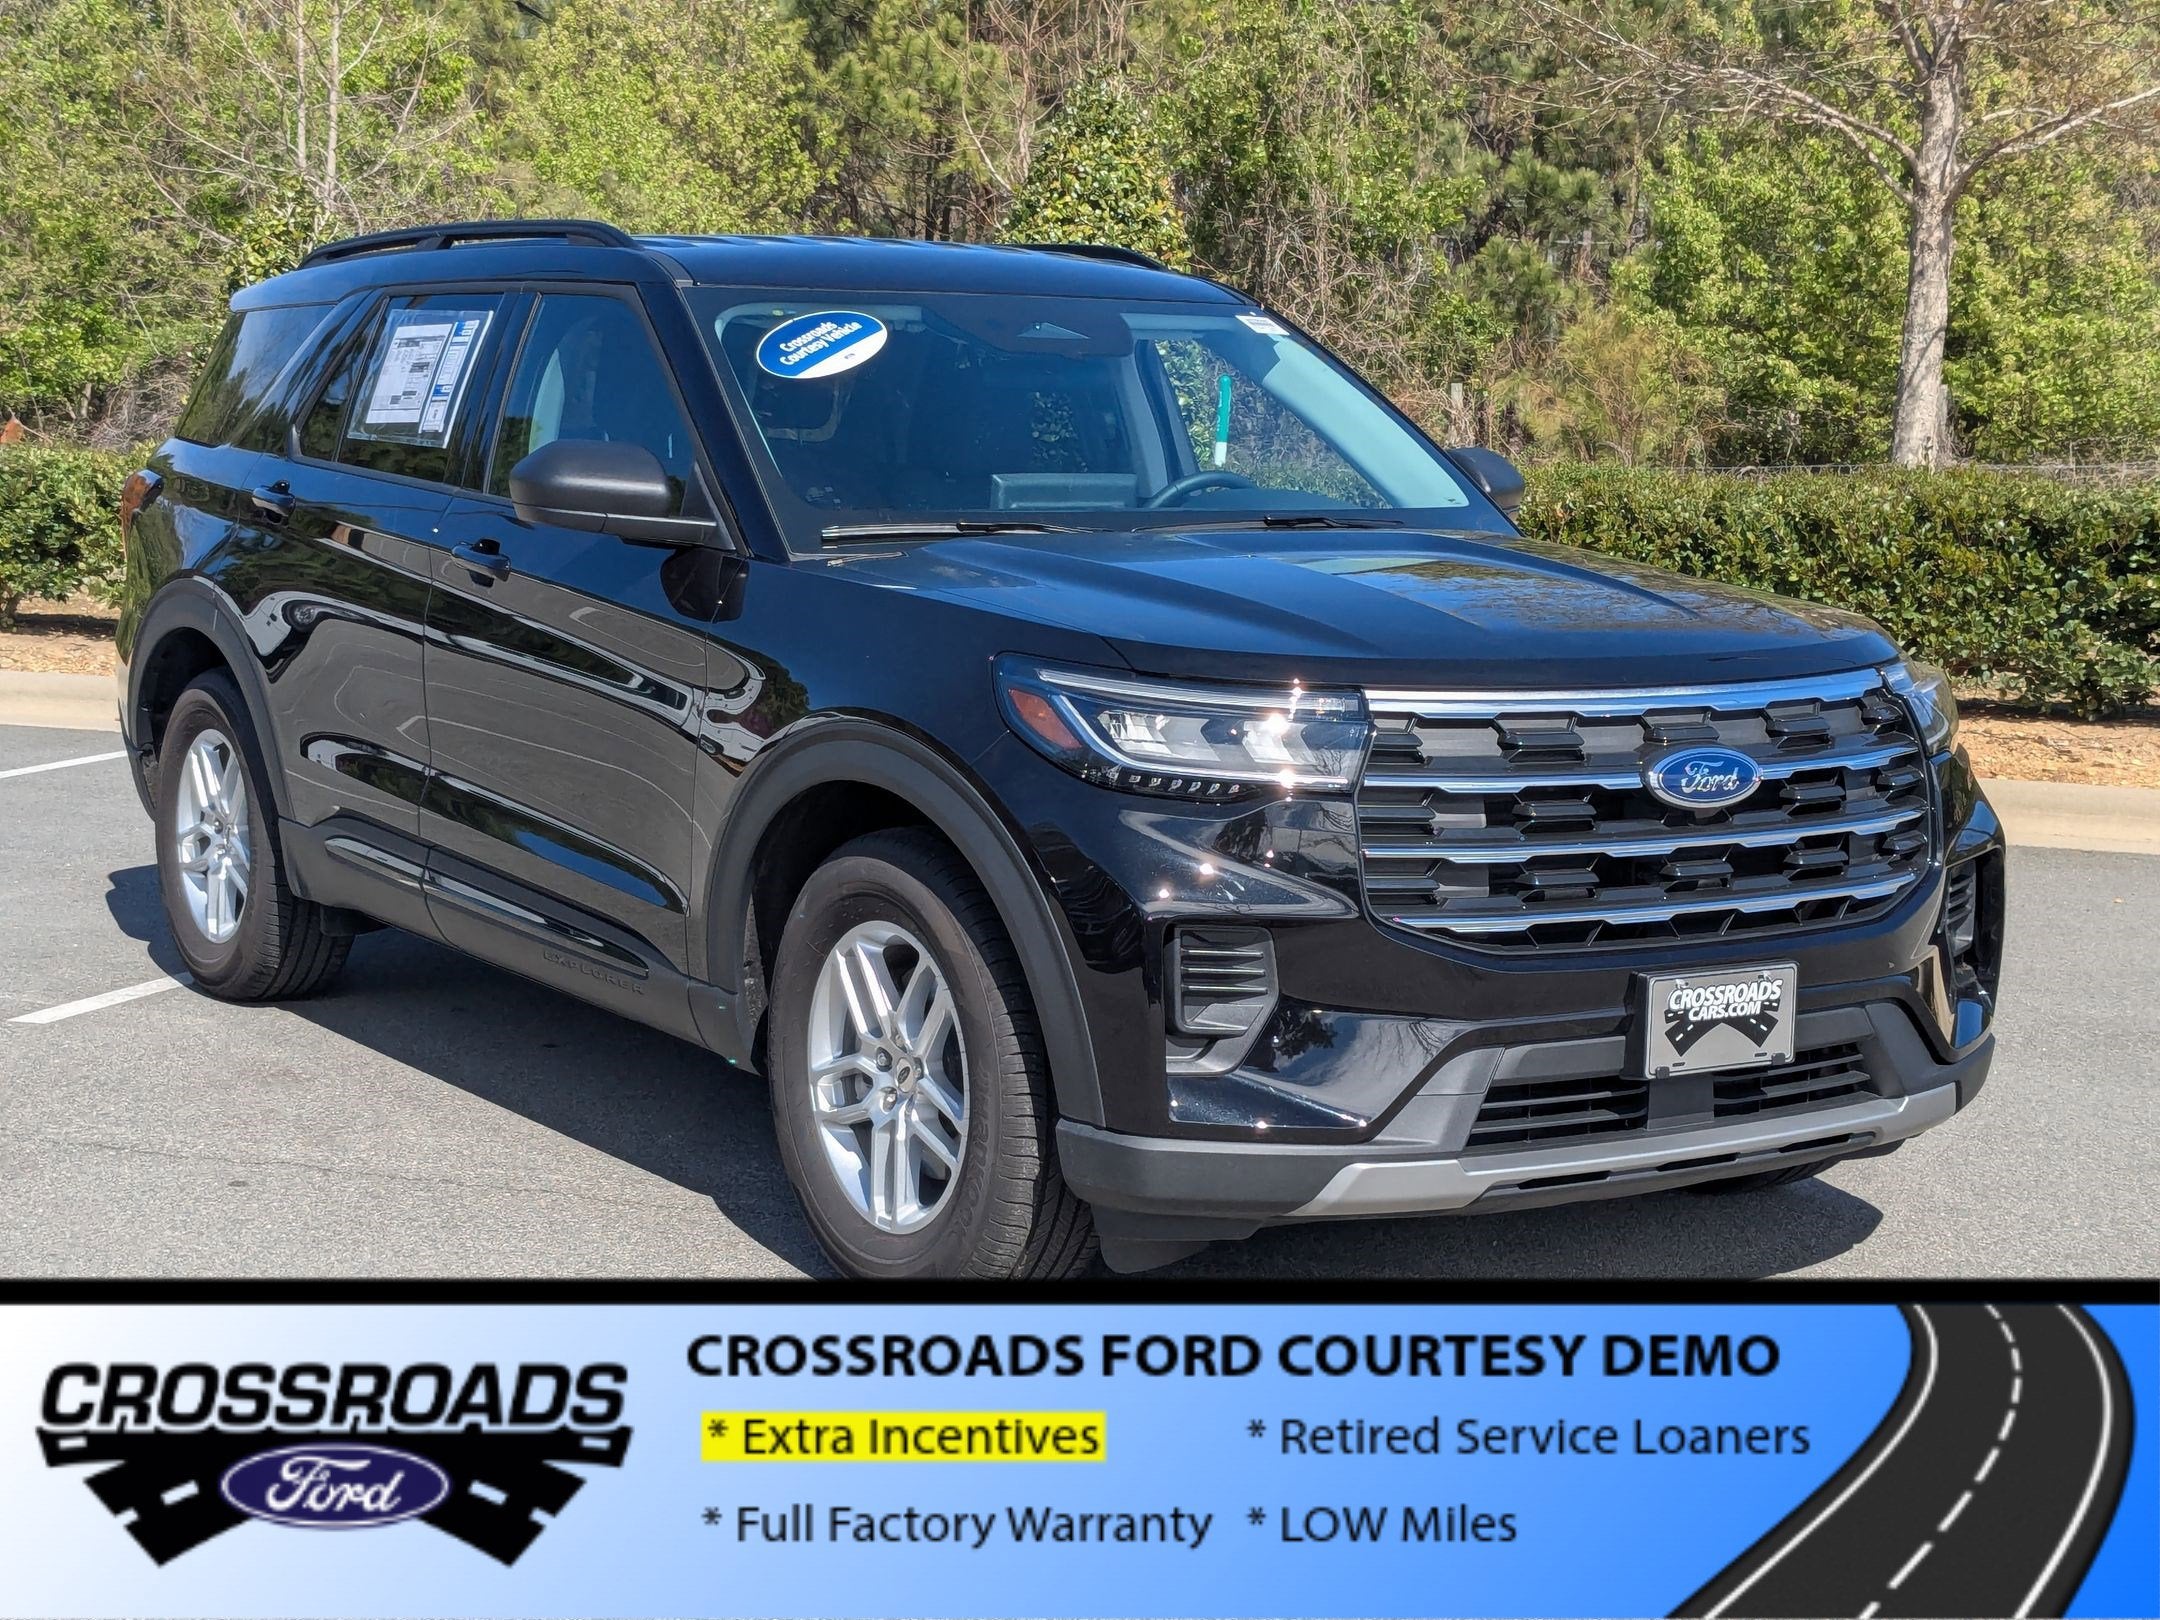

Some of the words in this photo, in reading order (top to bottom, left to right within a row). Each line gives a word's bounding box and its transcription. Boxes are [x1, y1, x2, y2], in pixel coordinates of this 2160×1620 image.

[779, 320, 838, 352] Crossroads
[779, 336, 830, 365] Courtesy
[824, 321, 863, 343] Vehicle
[1681, 758, 1740, 794] Ford
[543, 948, 645, 995] EXPLORER
[1669, 978, 1783, 1011] CROSSROADS
[1688, 1000, 1762, 1022] CARS.COM
